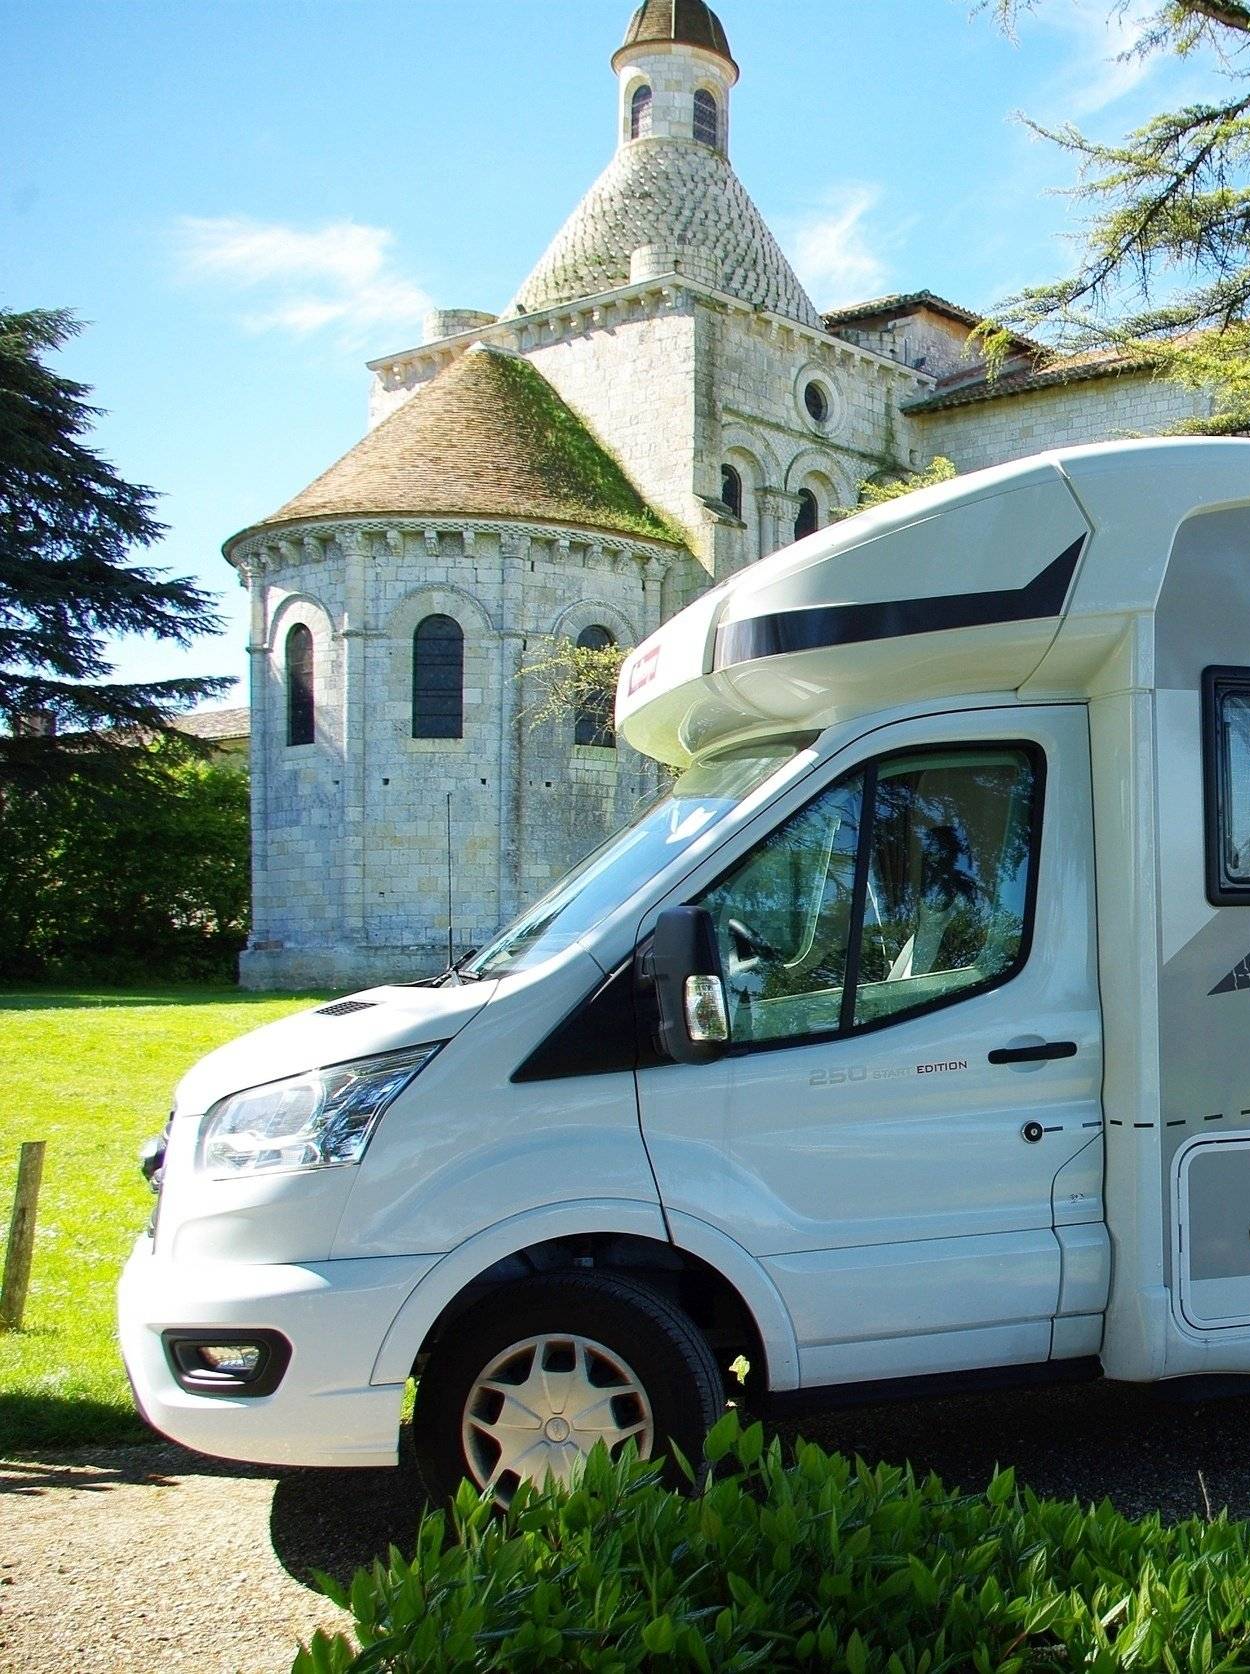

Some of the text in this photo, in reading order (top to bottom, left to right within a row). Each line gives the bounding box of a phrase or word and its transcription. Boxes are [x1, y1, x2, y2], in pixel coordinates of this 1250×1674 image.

[808, 1061, 968, 1086] 250 START EDITION
